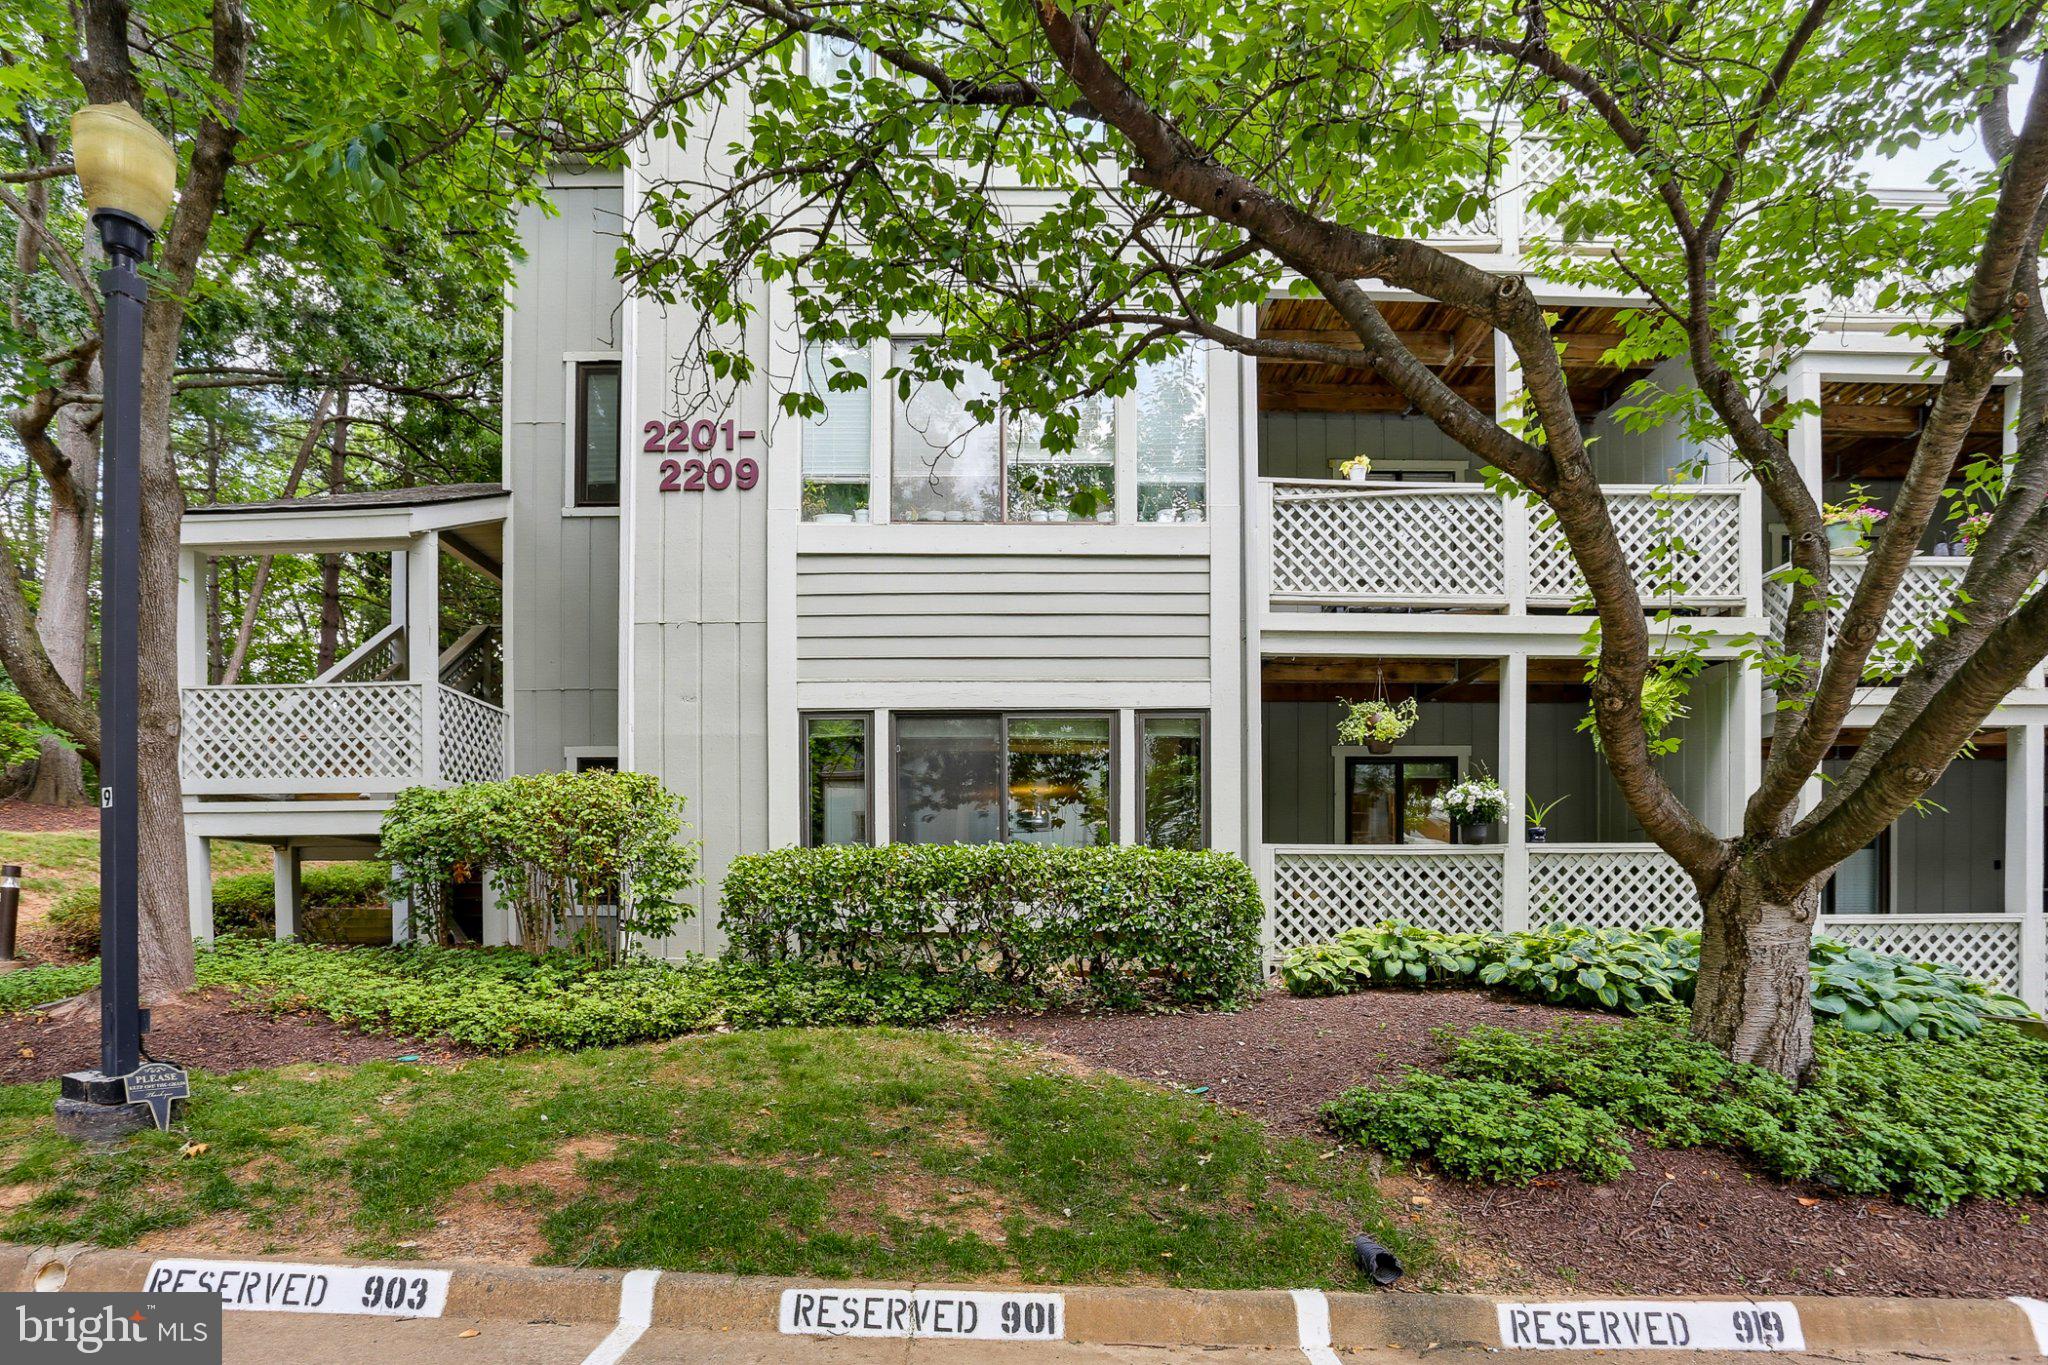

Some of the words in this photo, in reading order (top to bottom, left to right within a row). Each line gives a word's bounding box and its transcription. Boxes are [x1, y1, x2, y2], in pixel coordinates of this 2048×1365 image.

[643, 419, 756, 452] 2201-
[660, 458, 759, 491] 2209
[103, 789, 111, 807] 9
[135, 1073, 178, 1084] PLEASE
[150, 1268, 327, 1307] RESERVED
[361, 1275, 428, 1310] 903
[793, 1293, 978, 1334] RESERVED
[1001, 1301, 1054, 1334] 901
[1510, 1309, 1690, 1346] RESERVED
[1732, 1310, 1785, 1344] 919
